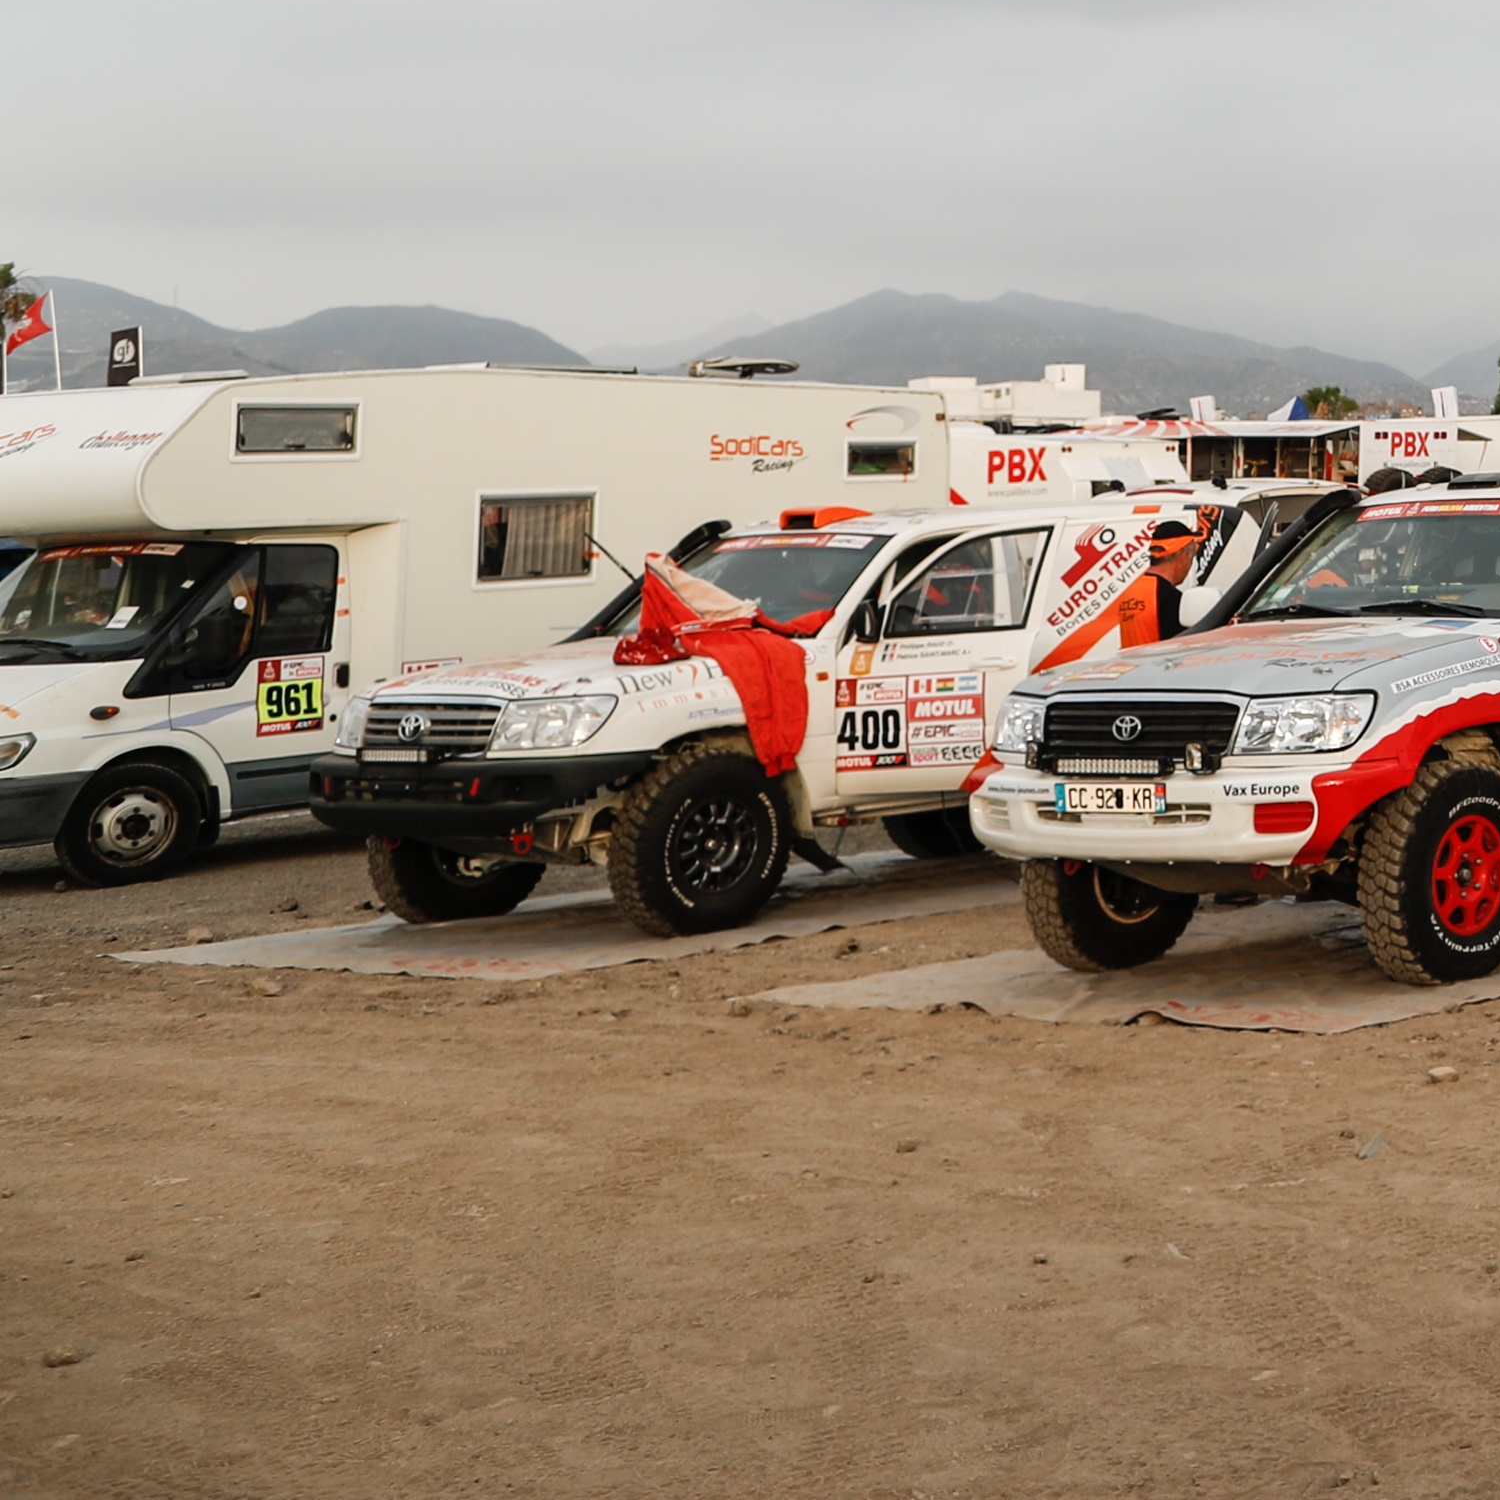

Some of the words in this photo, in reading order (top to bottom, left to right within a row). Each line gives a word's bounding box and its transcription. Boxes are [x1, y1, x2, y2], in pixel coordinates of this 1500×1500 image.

[710, 435, 803, 458] SodiCars
[1391, 432, 1430, 457] PBX
[752, 459, 796, 475] Racing
[988, 447, 1047, 484] PBX
[1365, 506, 1404, 519] MOTUL
[1438, 504, 1462, 512] BOLIVIA
[1462, 503, 1499, 512] ARGENTINA
[1047, 520, 1160, 627] EURO-TRANS
[1056, 599, 1101, 637] BOITES
[1101, 581, 1119, 602] DE
[615, 670, 672, 694] new
[1395, 681, 1412, 692] BSA
[1412, 667, 1460, 687] ACCESSOIRES
[266, 683, 317, 717] 961
[914, 699, 976, 717] MOTUL
[260, 722, 292, 732] MOTUL
[837, 709, 900, 750] 400
[837, 757, 872, 768] MOTUL
[1223, 784, 1247, 797] Vax
[1251, 784, 1299, 798] Europe
